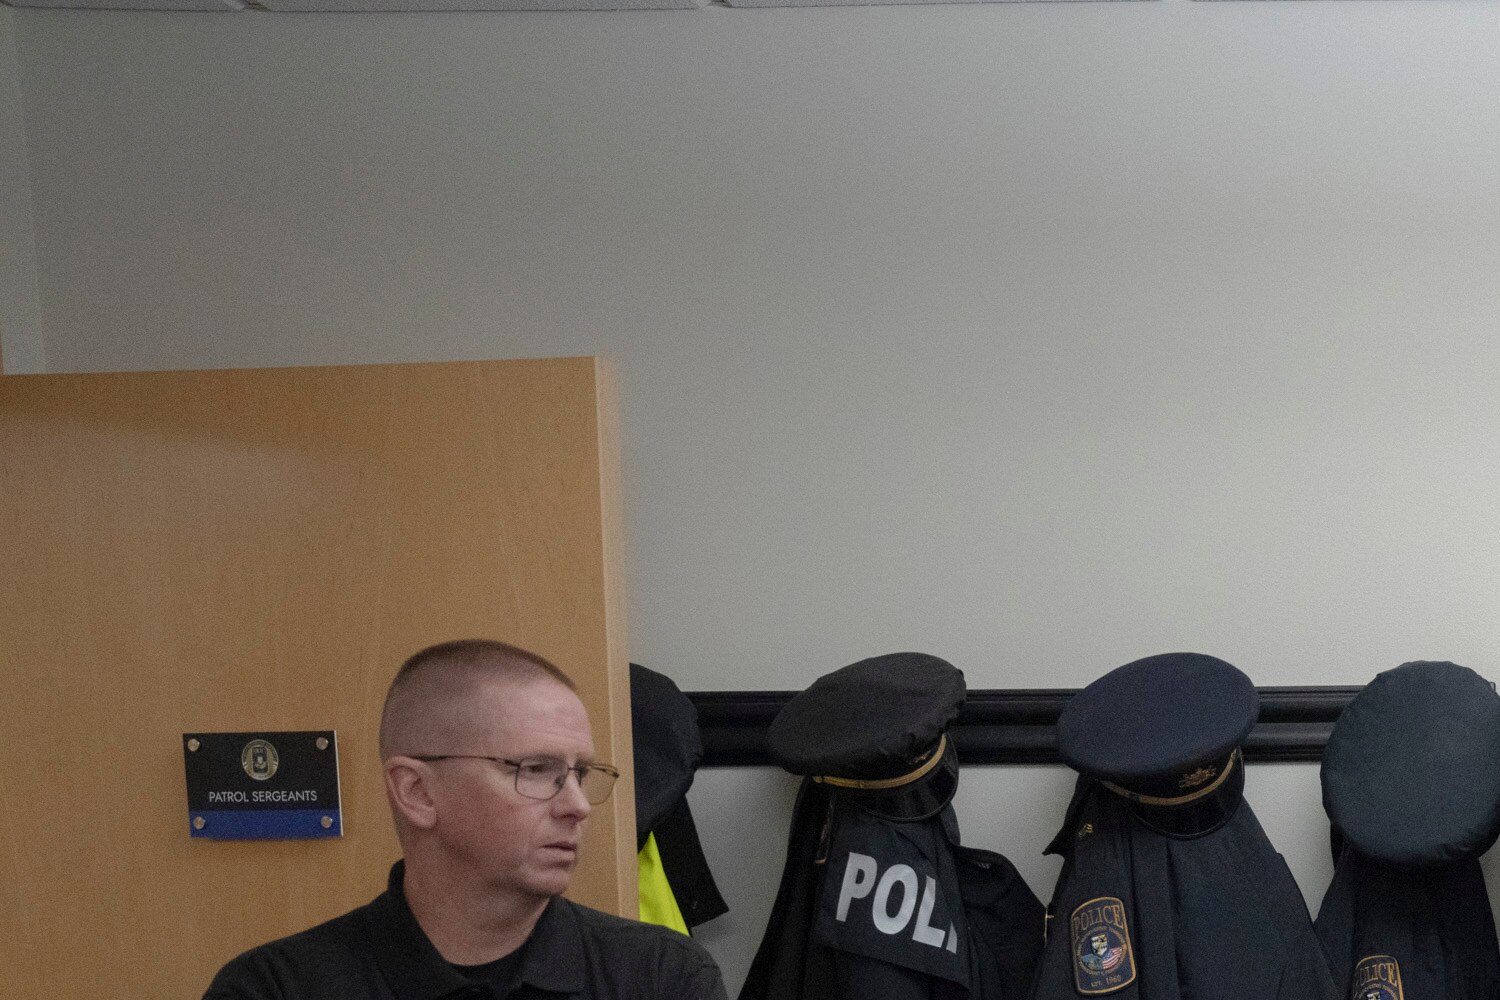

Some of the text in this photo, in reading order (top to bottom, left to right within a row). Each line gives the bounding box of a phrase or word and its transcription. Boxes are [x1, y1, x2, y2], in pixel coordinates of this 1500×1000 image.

[209, 790, 318, 803] PATROL SERGEANTS
[1073, 904, 1124, 943] POLICE
